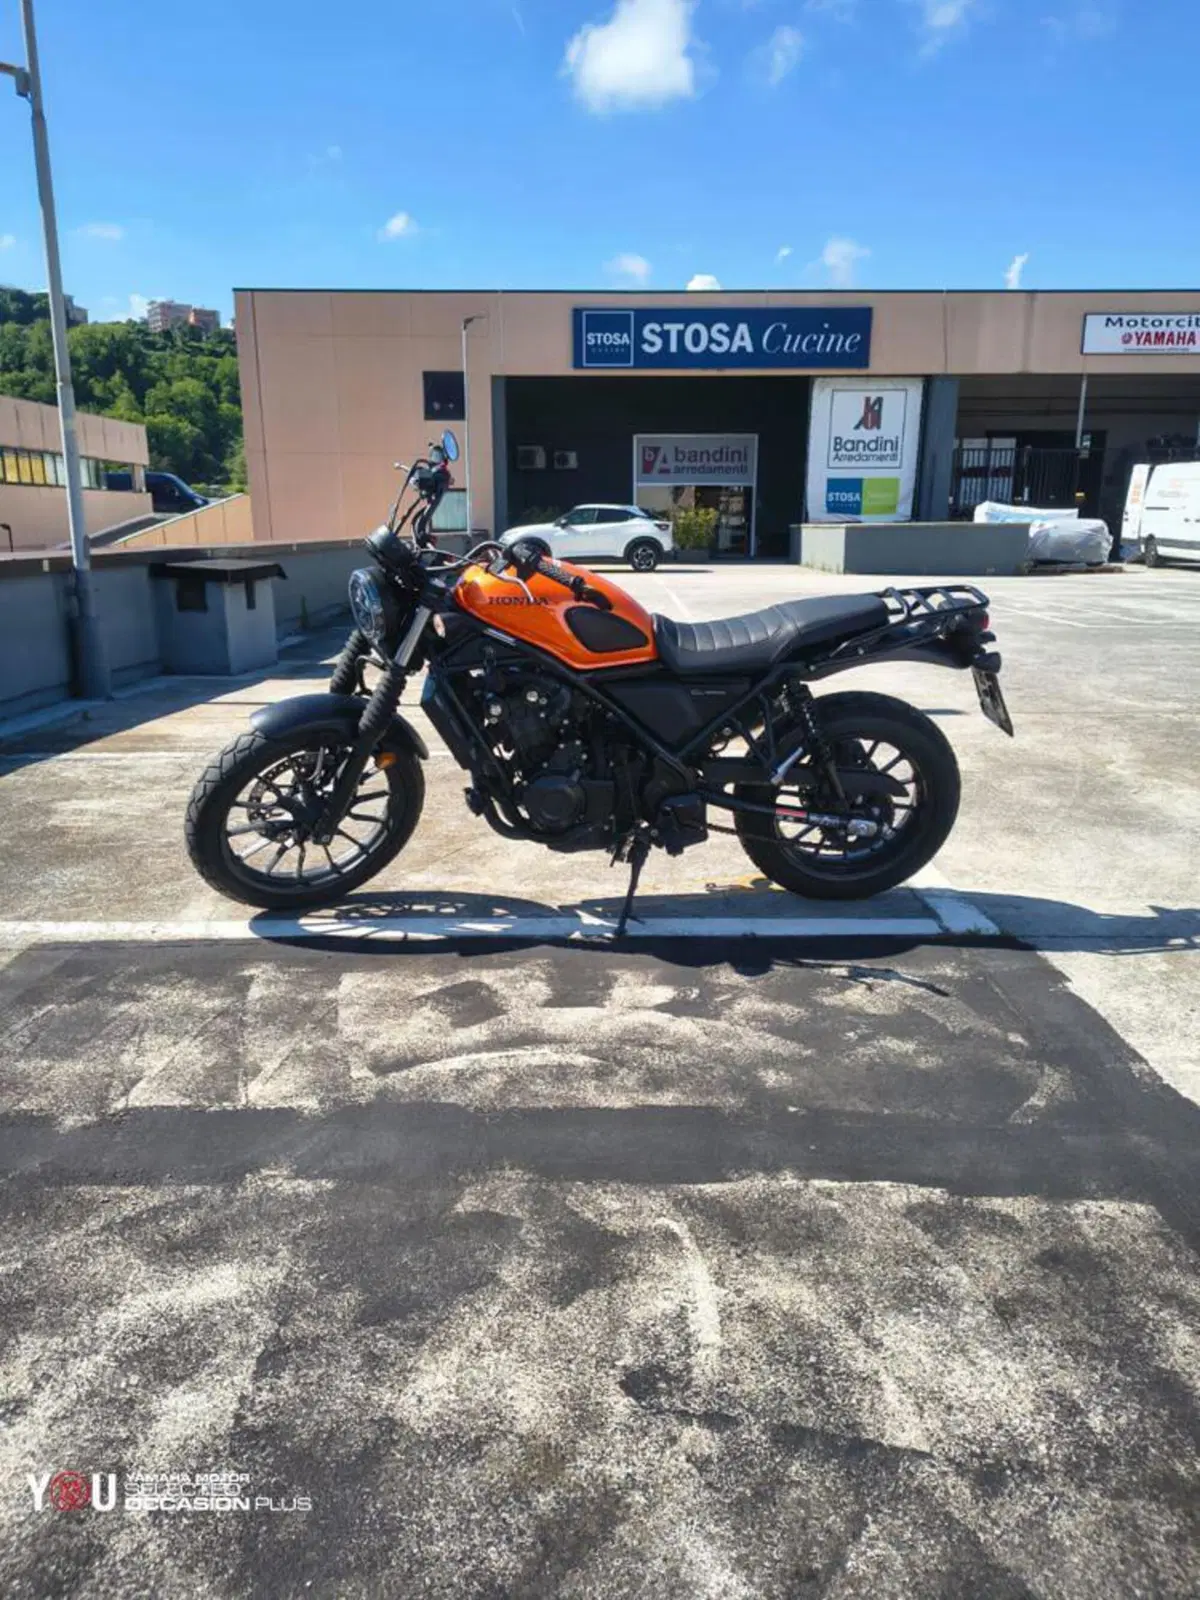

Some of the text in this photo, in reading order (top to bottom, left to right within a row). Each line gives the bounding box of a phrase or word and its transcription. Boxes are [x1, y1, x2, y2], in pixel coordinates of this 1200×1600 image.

[586, 332, 630, 345] STOSA
[641, 322, 861, 354] STOSA Cucine
[1135, 331, 1196, 346] YAMAHA
[832, 436, 898, 453] Bandini
[674, 446, 748, 462] bandini
[832, 452, 898, 462] Arredamenti
[673, 464, 748, 475] arredamenti
[828, 492, 861, 502] STOSA
